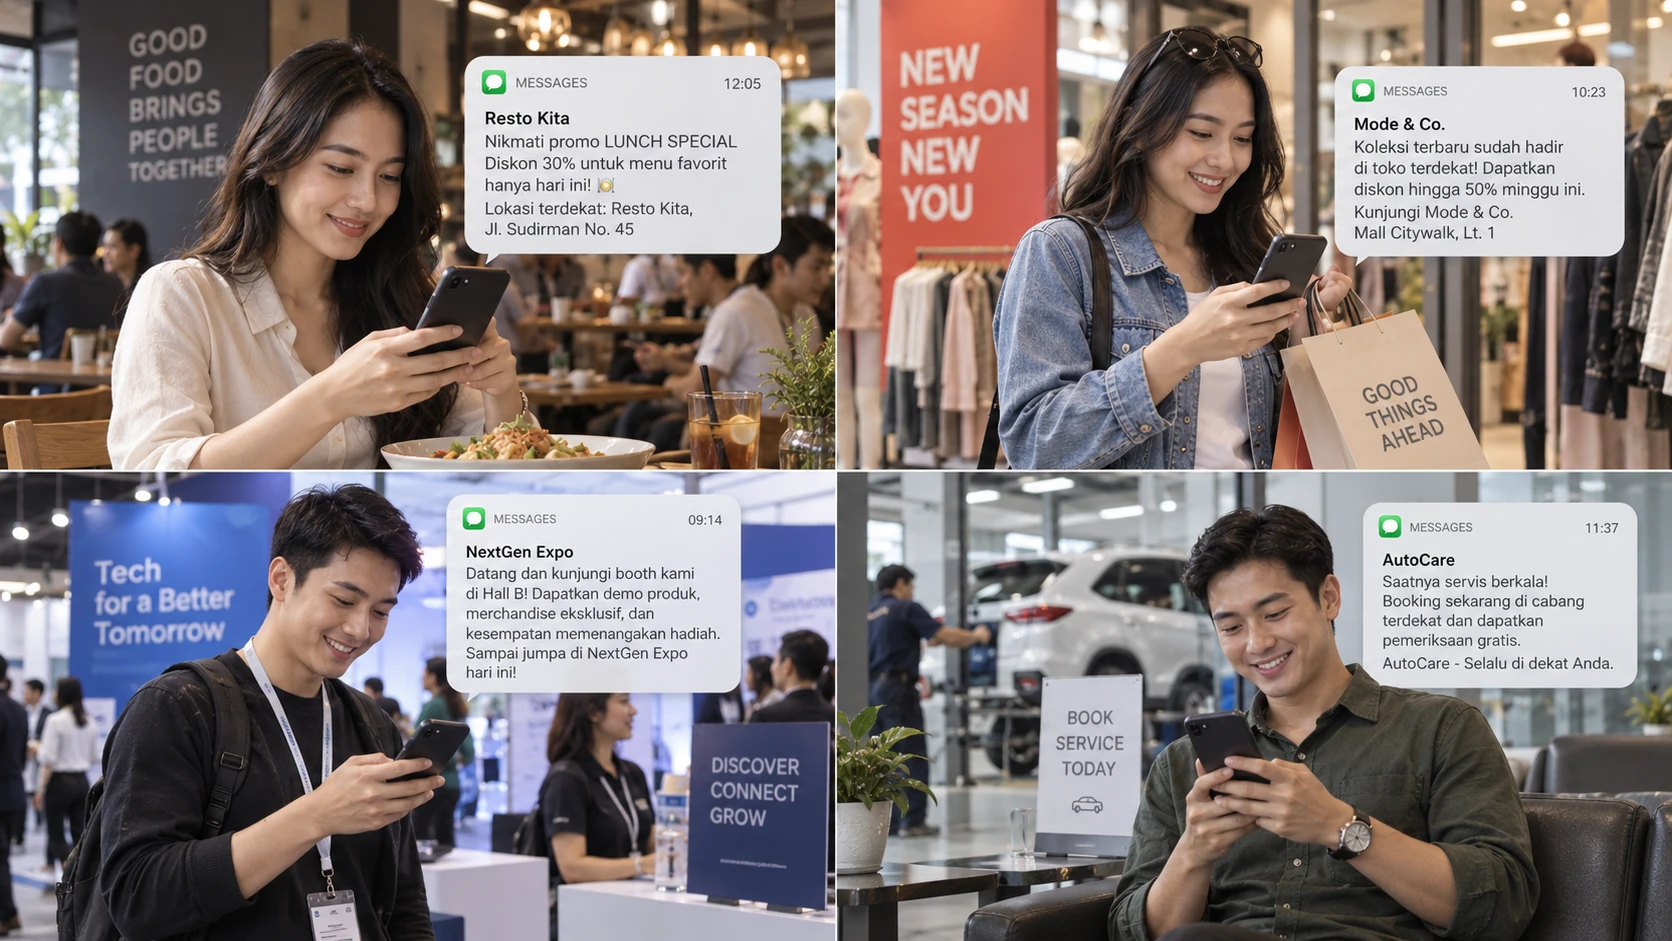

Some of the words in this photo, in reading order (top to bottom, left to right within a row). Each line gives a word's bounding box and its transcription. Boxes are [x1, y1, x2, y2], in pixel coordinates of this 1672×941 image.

[129, 24, 208, 58] GOOD
[130, 58, 203, 90] FOOD
[900, 43, 980, 87] NEW
[129, 90, 222, 123] BRINGS
[900, 87, 1029, 131] SEASON
[129, 123, 218, 155] PEOPLE
[128, 155, 227, 183] TOGETHER
[900, 135, 981, 176] NEW
[900, 183, 973, 223] YOU
[1362, 375, 1419, 405] GOOD
[1365, 394, 1438, 429] THINGS
[1381, 418, 1445, 452] AHEAD
[94, 557, 161, 585] Tech
[95, 589, 132, 616] for
[137, 597, 152, 613] a
[159, 587, 235, 613] Better
[94, 619, 226, 646] Tomorrow
[1067, 710, 1114, 726] BOOK
[1055, 735, 1124, 752] SERVICE
[711, 757, 800, 777] DISCOVER
[1062, 761, 1116, 776] TODAY
[710, 781, 799, 803] CONNECT
[709, 807, 767, 828] GROW
